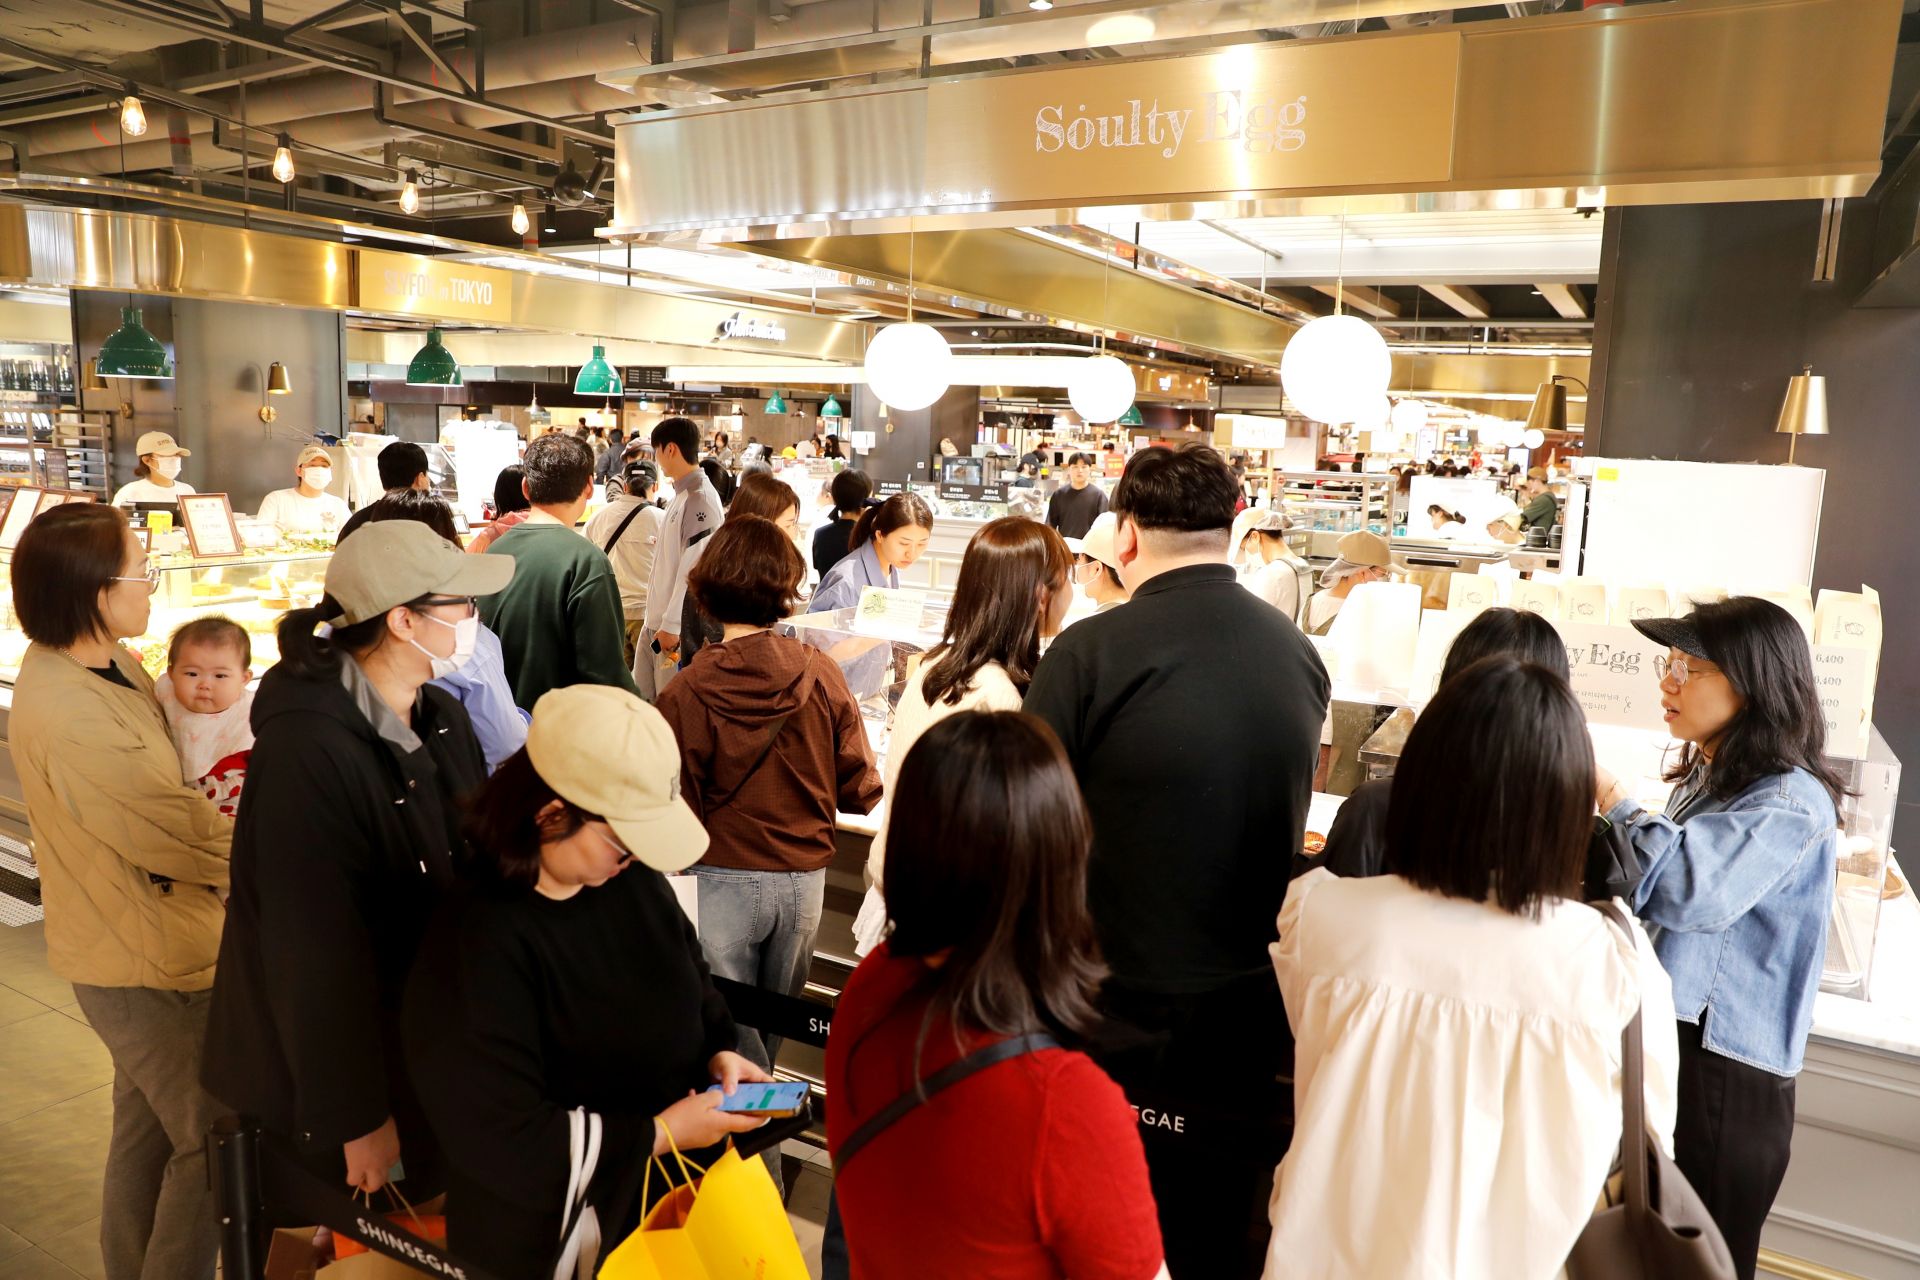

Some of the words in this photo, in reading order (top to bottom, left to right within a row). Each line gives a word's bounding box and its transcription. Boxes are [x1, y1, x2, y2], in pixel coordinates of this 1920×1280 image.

[1035, 98, 1192, 158] Soulty
[1197, 90, 1307, 153] Egg
[449, 278, 493, 305] TOKYO
[1586, 643, 1641, 675] Egg
[1815, 653, 1844, 665] 6,400
[809, 1017, 831, 1036] SH
[356, 1217, 467, 1280] SHINSEGAE
